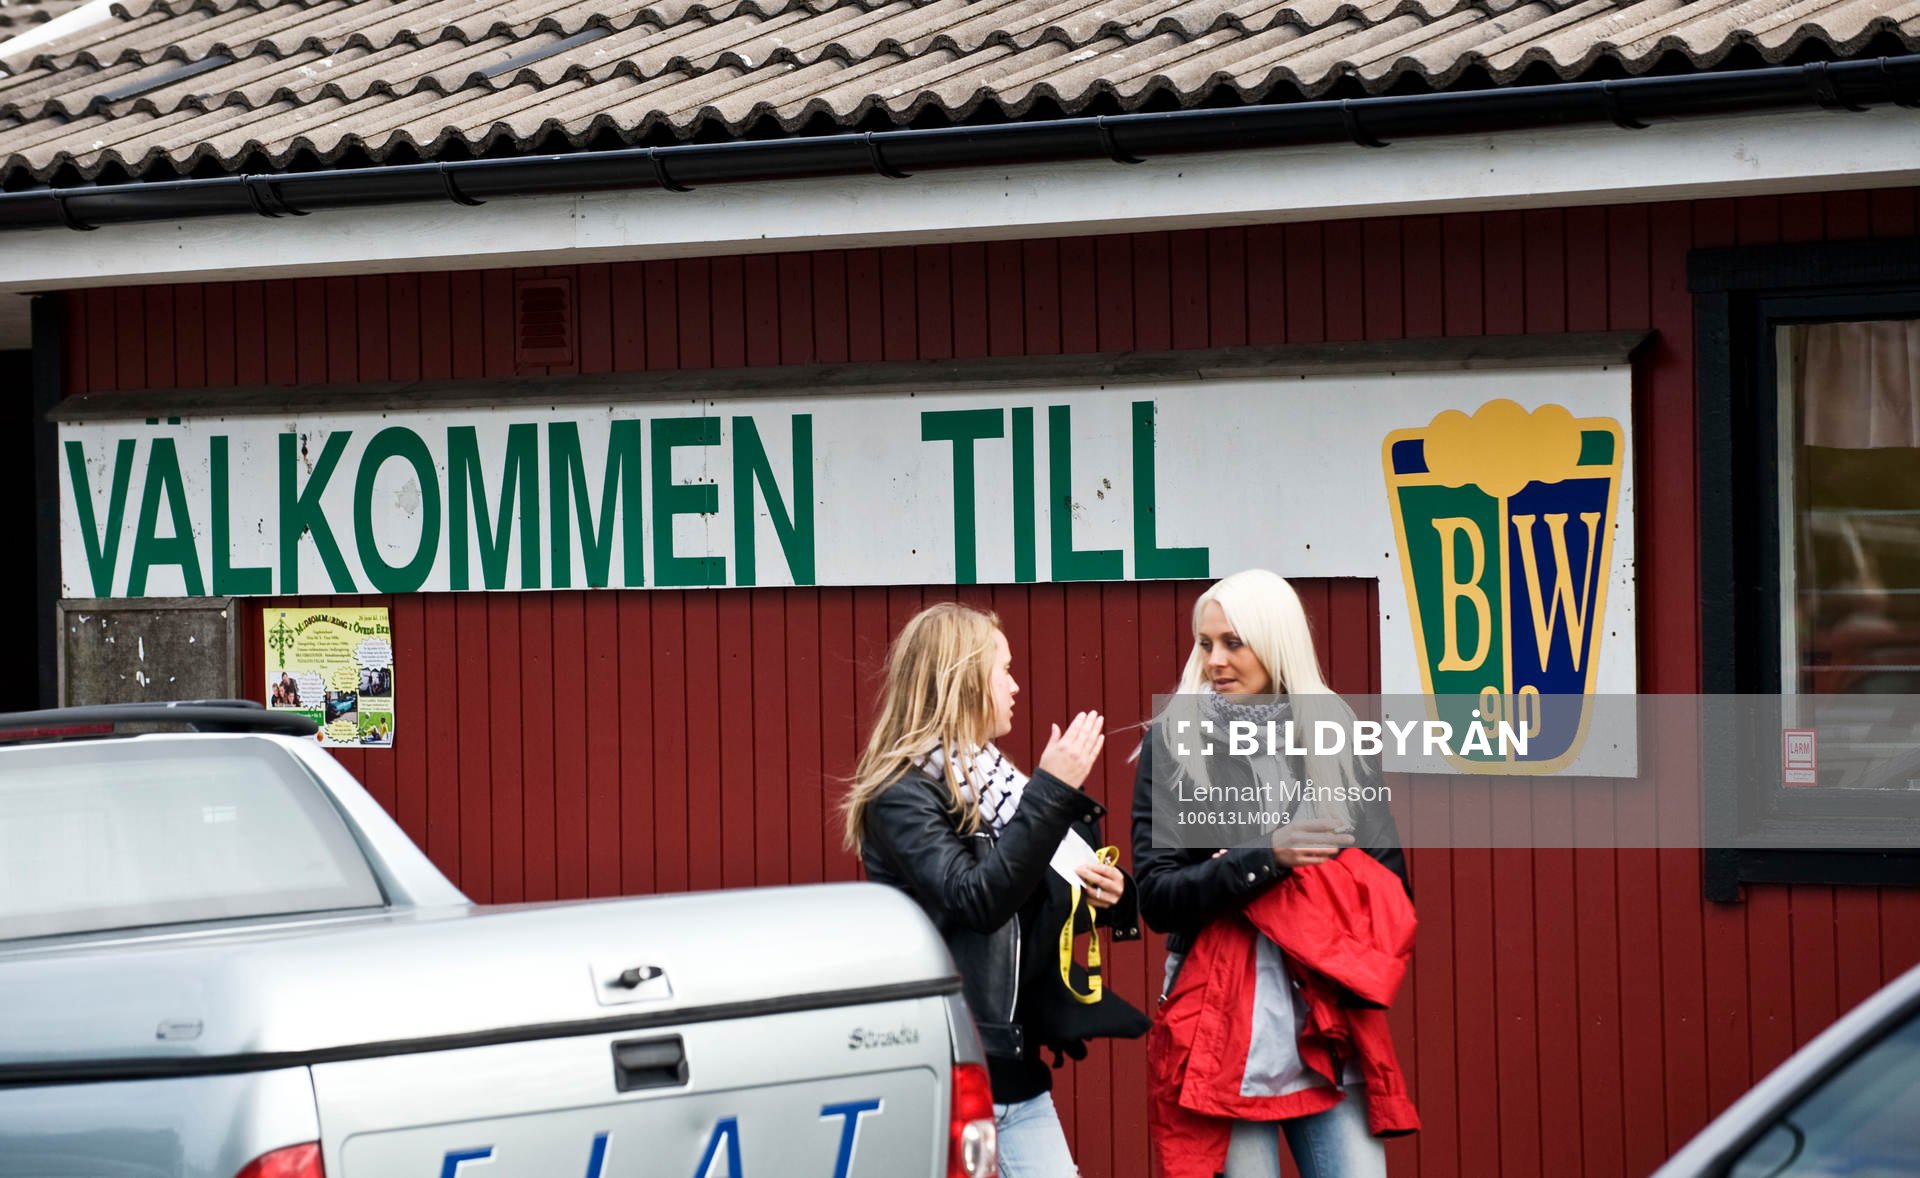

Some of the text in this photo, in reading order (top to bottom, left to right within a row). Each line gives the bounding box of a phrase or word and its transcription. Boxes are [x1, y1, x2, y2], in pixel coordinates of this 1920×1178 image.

[63, 400, 1210, 598] VÄLKOMMEN TILL
[1790, 743, 1810, 755] LARM
